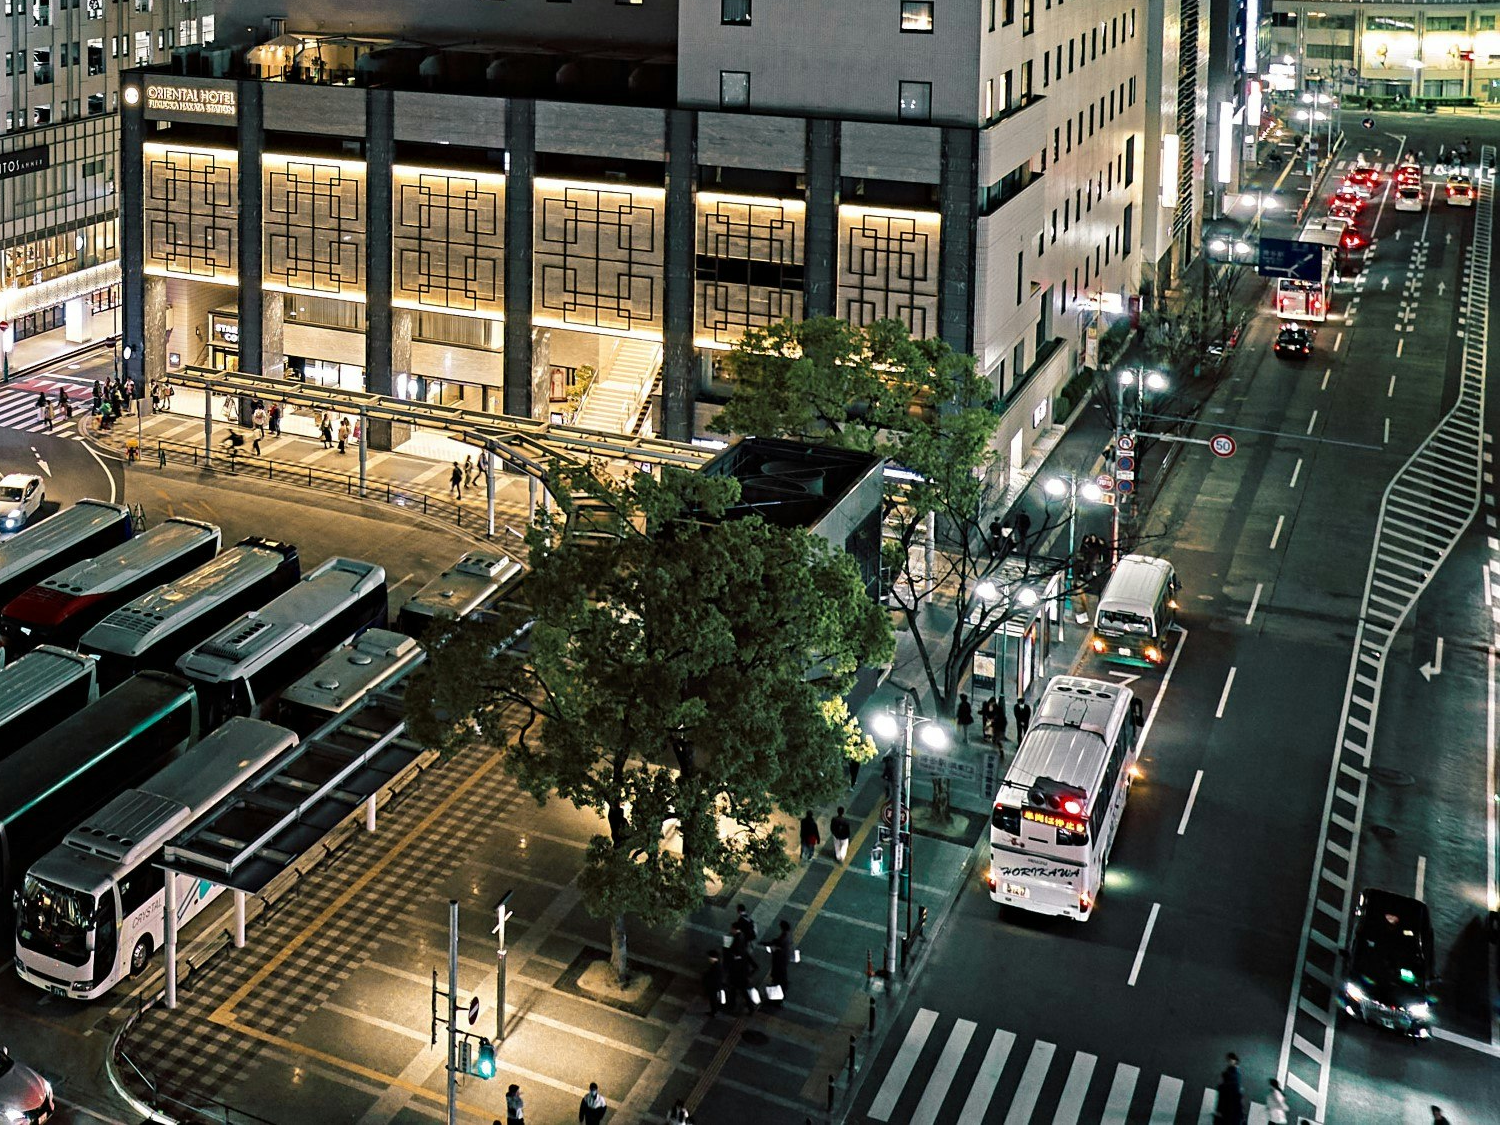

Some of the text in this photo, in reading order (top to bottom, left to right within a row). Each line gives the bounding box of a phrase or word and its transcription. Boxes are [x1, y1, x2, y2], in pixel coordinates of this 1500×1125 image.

[147, 86, 236, 105] ORIENTAL HOTEL
[1216, 440, 1231, 452] 50
[1001, 866, 1080, 878] HORIKAWA
[131, 901, 162, 929] CRYSTAL
